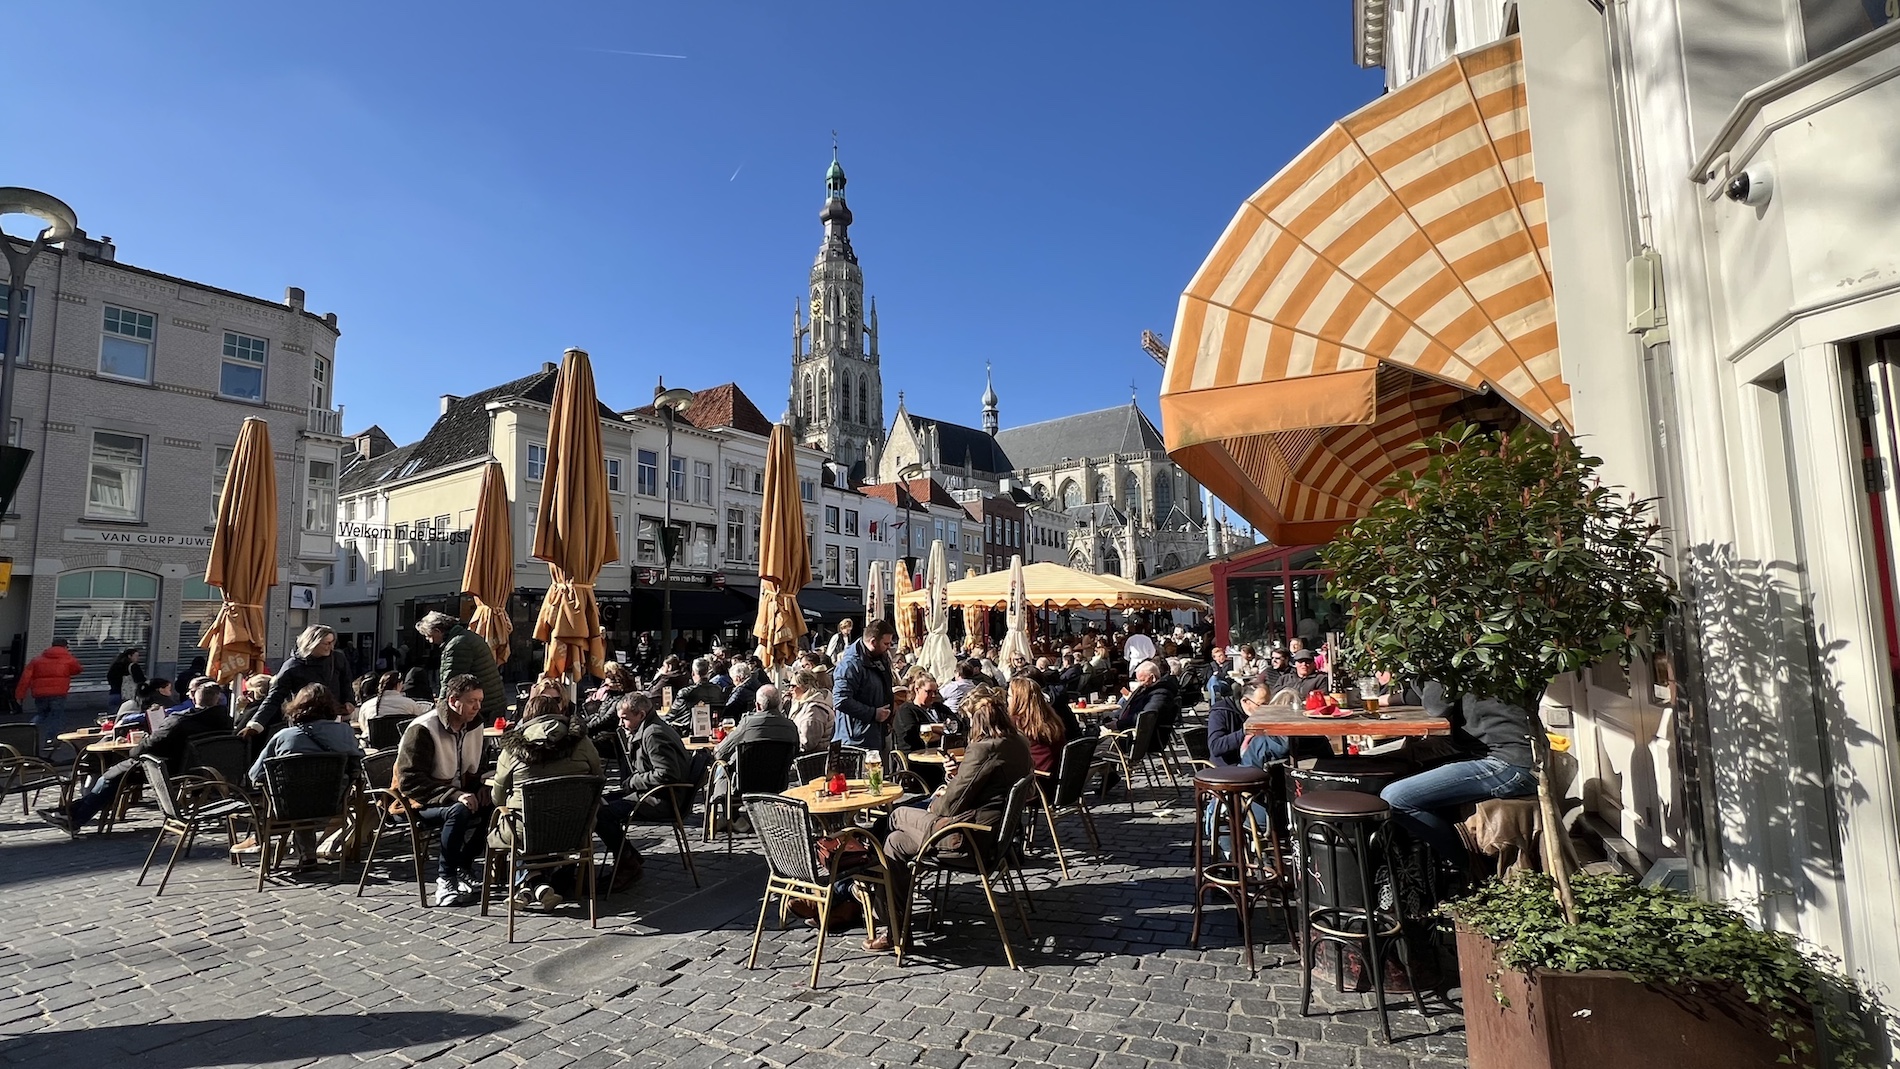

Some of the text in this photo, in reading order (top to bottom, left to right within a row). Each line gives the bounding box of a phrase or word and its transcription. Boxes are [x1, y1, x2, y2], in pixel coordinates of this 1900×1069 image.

[101, 532, 212, 546] VAN GURP JUWE
[339, 521, 392, 540] Welkom
[395, 526, 406, 540] in
[409, 527, 425, 541] de
[221, 653, 246, 673] afé
